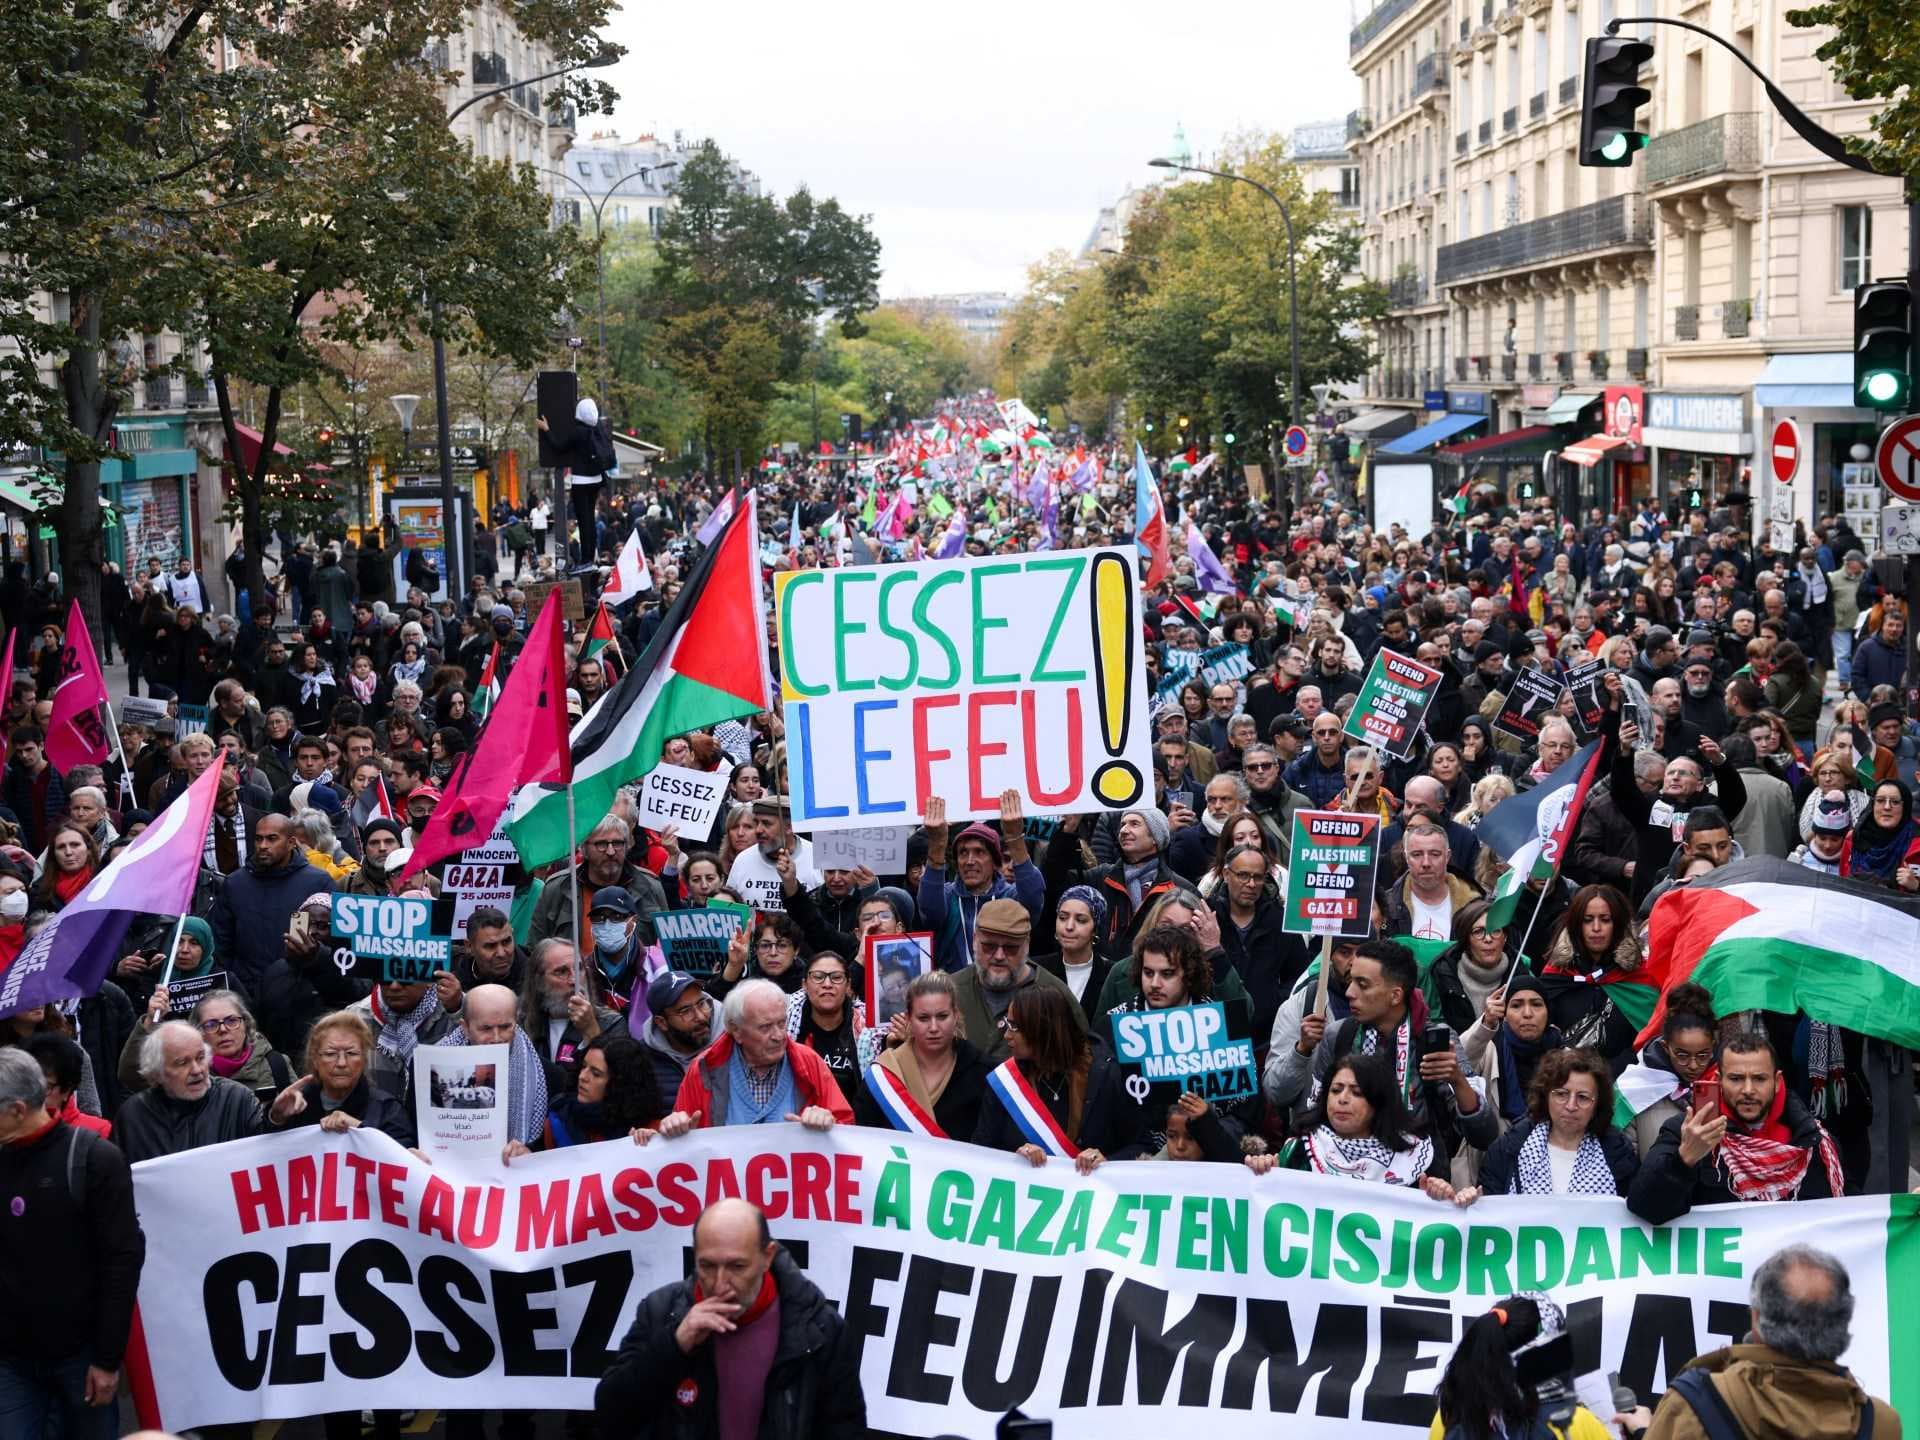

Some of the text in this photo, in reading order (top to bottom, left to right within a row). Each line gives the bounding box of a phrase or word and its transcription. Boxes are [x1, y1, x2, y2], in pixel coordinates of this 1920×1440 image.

[782, 556, 1087, 697] CESSEZ
[1389, 660, 1425, 682] DEFEND
[1374, 678, 1424, 703] PALESTINE
[1371, 697, 1407, 719] DEFEND
[1365, 717, 1392, 735] GAZA
[798, 699, 906, 819] LE
[912, 687, 1084, 816] FEU
[651, 774, 716, 802] CESSEZ-
[648, 797, 702, 823] LE-FEU
[1312, 820, 1360, 836] DEFEND
[463, 850, 518, 860] INNOCENT
[1301, 848, 1367, 863] PALESTINE
[447, 865, 499, 889] GAZA
[1306, 873, 1354, 889] DEFEND
[461, 891, 512, 901] 35 JOURS
[1307, 902, 1343, 915] GAZA
[335, 896, 428, 938] STOP
[656, 913, 742, 939] MARCHE
[355, 935, 448, 960] MASSACRE
[388, 957, 444, 981] GAZA
[1118, 1007, 1221, 1058] STOP
[823, 1054, 853, 1070] AZA
[1145, 1044, 1250, 1077] MASSACRE
[1186, 1067, 1253, 1099] GAZA
[230, 1146, 1743, 1297] HALTE AU MASSACRE À GAZA ET EN CISJORDANIE
[203, 1238, 634, 1391] CESSEZ
